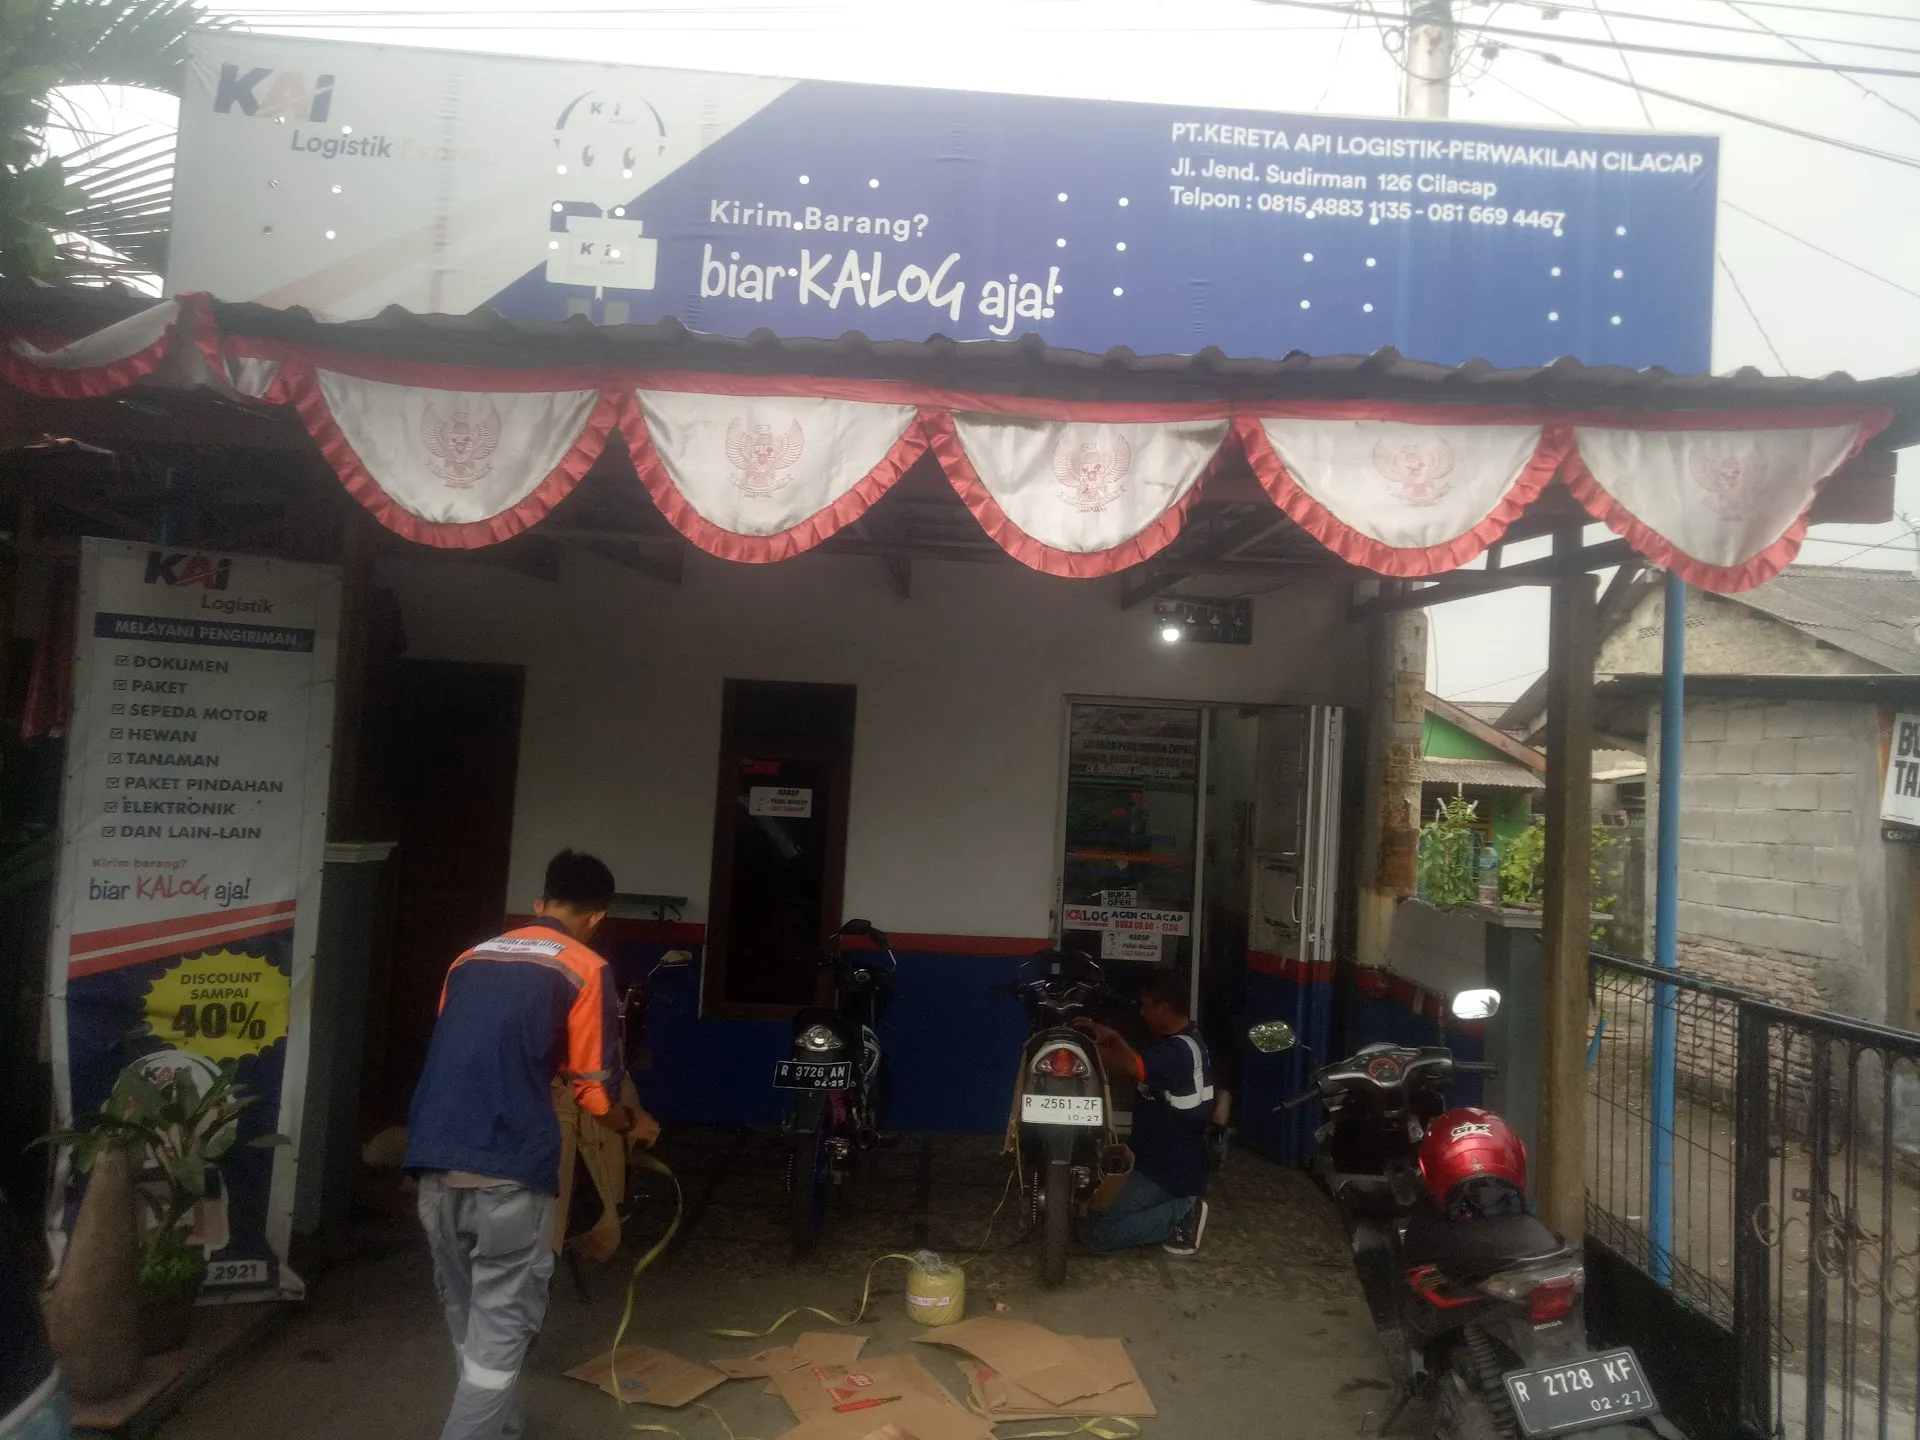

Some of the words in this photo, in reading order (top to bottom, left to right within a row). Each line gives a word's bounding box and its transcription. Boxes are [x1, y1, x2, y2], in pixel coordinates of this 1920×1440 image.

[291, 130, 393, 160] Logistik
[1171, 122, 1290, 150] PT.KERETA
[1294, 133, 1331, 153] API
[1602, 151, 1703, 173] CILACAP
[1171, 158, 1196, 177] Jl.
[1201, 159, 1260, 182] Jend.
[1266, 164, 1366, 190] Sudirman
[1378, 174, 1412, 192] 126
[1417, 174, 1497, 200] Cilacap
[1170, 185, 1240, 210] Telpon
[1258, 193, 1306, 213] 0815
[1311, 197, 1363, 217] 4883
[1368, 201, 1411, 220] 1135
[1428, 203, 1463, 222] 081
[1468, 206, 1508, 225] 669
[1512, 209, 1565, 231] 4467
[710, 199, 792, 228] Kirim
[804, 206, 929, 242] Barang?
[700, 243, 786, 302] biar
[800, 248, 966, 322] KALOG
[978, 266, 1060, 335] aja!
[144, 551, 231, 590] KAI
[201, 594, 275, 614] Logistik
[115, 619, 196, 639] MELAYANI
[199, 625, 299, 646] PENGIRIMAN
[134, 655, 229, 673] DOKUMEN
[131, 679, 188, 695] PAKET
[129, 703, 198, 720] SEPEDA
[203, 707, 268, 723] MOTOR
[128, 727, 197, 744] HEWAN
[126, 752, 220, 768] TANAMAN
[124, 776, 181, 790] PAKET
[186, 778, 283, 793] PINDAHAN
[1894, 759, 1920, 799] TA
[122, 800, 236, 816] ELEKTRONIK
[120, 825, 162, 838] DAN
[168, 826, 262, 839] LAIN-LAIN
[92, 856, 129, 868] Kirim
[134, 858, 188, 871] barang?
[88, 877, 131, 901] biar
[136, 874, 210, 901] KALOG
[214, 877, 252, 908] aja!
[1107, 899, 1132, 907] OPEN
[1111, 910, 1138, 919] AGEN
[1140, 912, 1184, 923] CILACAP
[180, 972, 263, 985] DISCOUNT
[190, 987, 249, 1000] SAMPAI
[171, 1001, 266, 1040] 40%
[781, 1064, 789, 1076] R
[795, 1066, 824, 1077] 3726
[830, 1066, 845, 1078] AN
[1025, 1096, 1032, 1108] R
[1044, 1098, 1072, 1109] 2561
[1083, 1102, 1098, 1110] ZF
[214, 1264, 258, 1279] 2921
[1514, 1381, 1531, 1403] R
[1543, 1368, 1594, 1397] 2728
[1603, 1358, 1631, 1384] KF
